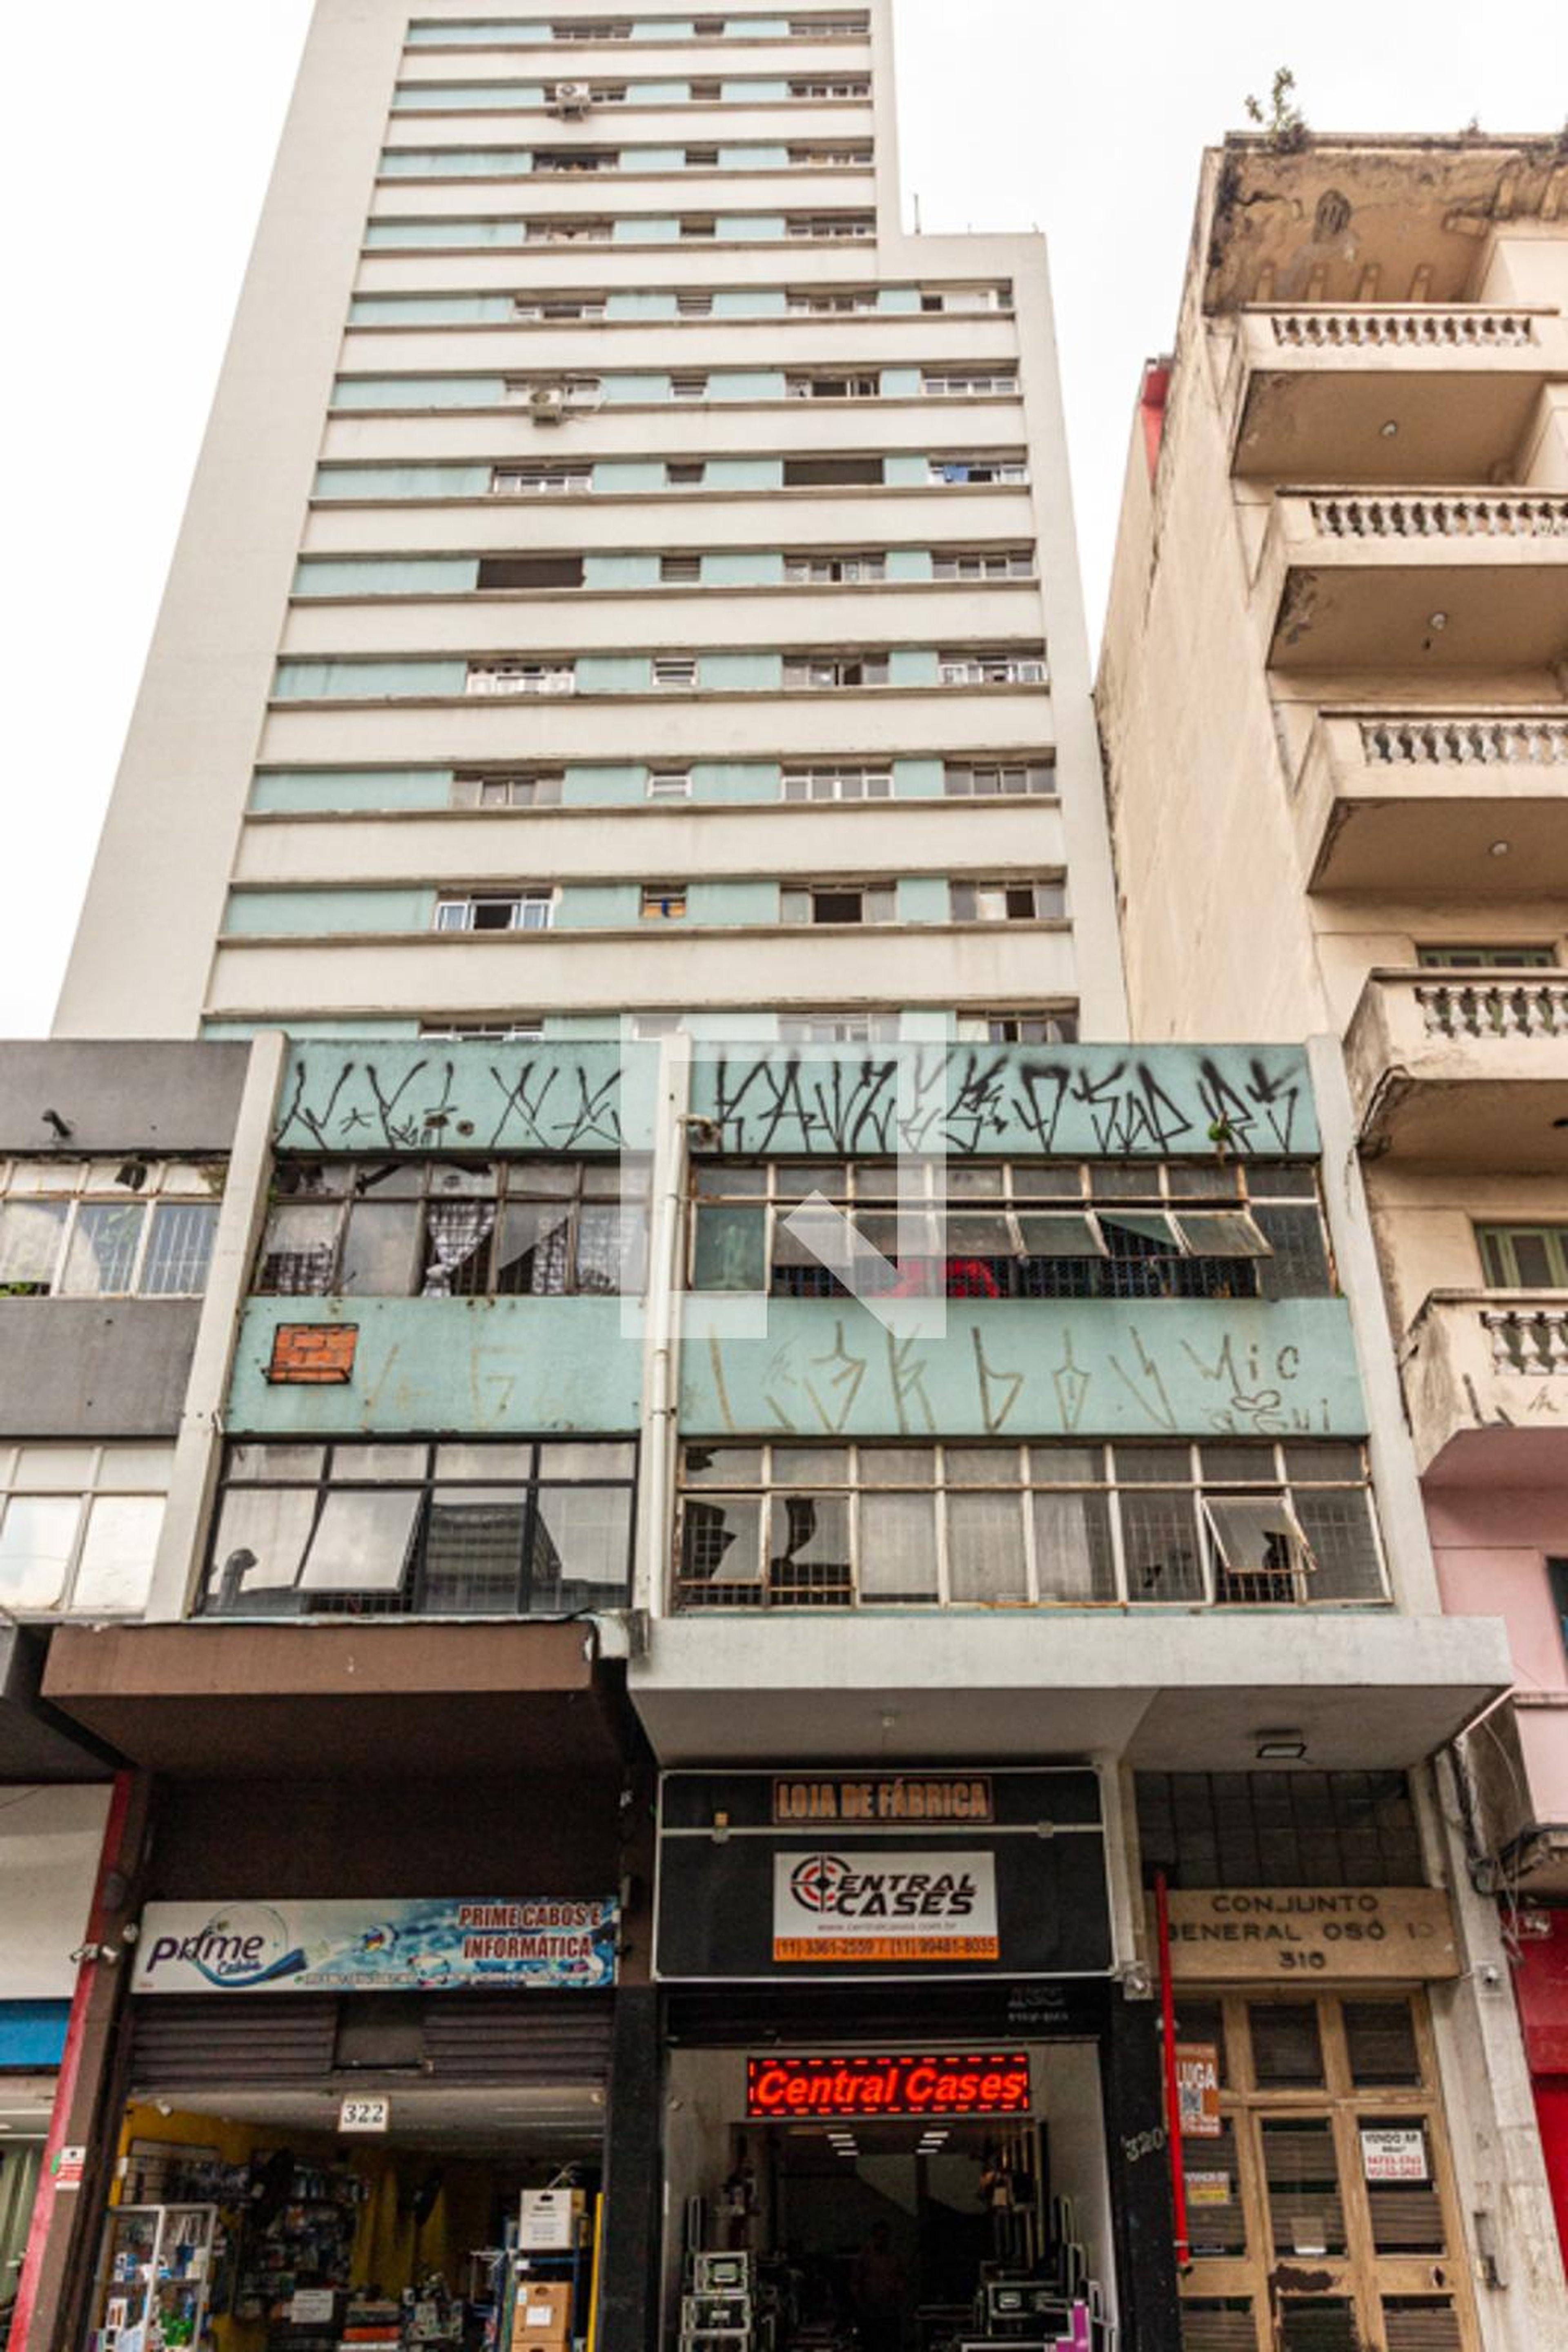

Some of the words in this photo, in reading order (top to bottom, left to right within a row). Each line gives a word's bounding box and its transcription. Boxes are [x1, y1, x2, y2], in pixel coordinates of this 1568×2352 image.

[779, 1784, 837, 1818] LOJA
[840, 1784, 874, 1818] DE
[878, 1776, 987, 1818] FÁBRICA
[459, 1907, 516, 1927] PRIME
[522, 1904, 586, 1926] CABOS
[590, 1904, 601, 1926] E
[835, 1891, 976, 1917] CASES
[1212, 1893, 1379, 1913] CONJUNTO
[146, 1927, 265, 1973] prime
[464, 1933, 592, 1958] INFORMÁTICA
[757, 2066, 899, 2105] Central
[904, 2065, 1024, 2103] Cases
[1174, 2062, 1218, 2090] LUGA
[344, 2104, 383, 2123] 322
[1125, 2127, 1165, 2162] 320
